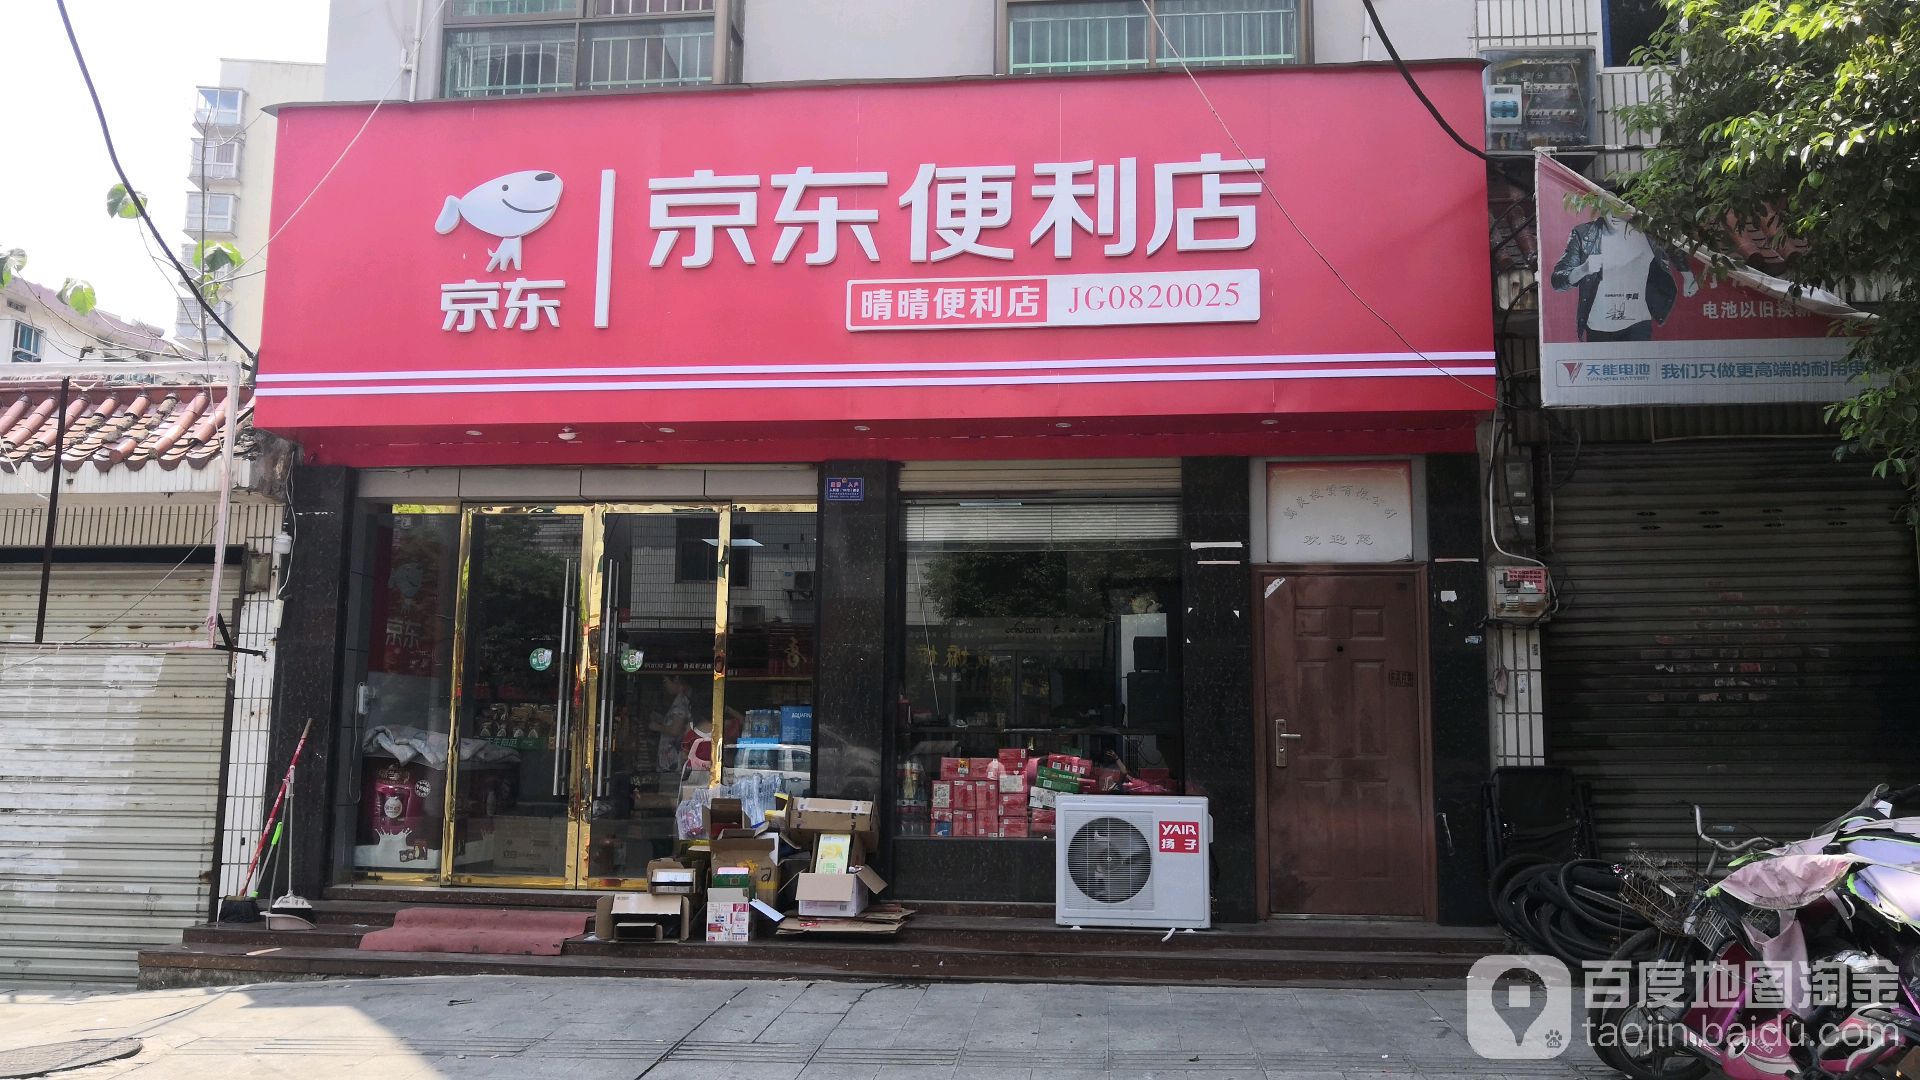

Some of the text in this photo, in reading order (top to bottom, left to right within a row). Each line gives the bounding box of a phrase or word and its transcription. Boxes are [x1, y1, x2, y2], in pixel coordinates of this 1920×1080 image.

[648, 153, 1266, 269] 京东便利店
[440, 277, 566, 333] 京东
[861, 285, 1041, 321] 晴晴便利店
[1067, 281, 1241, 314] JG0820025
[1585, 363, 1650, 376] 天能电池
[1161, 824, 1197, 836] YAIR
[1161, 838, 1197, 850] 扬子
